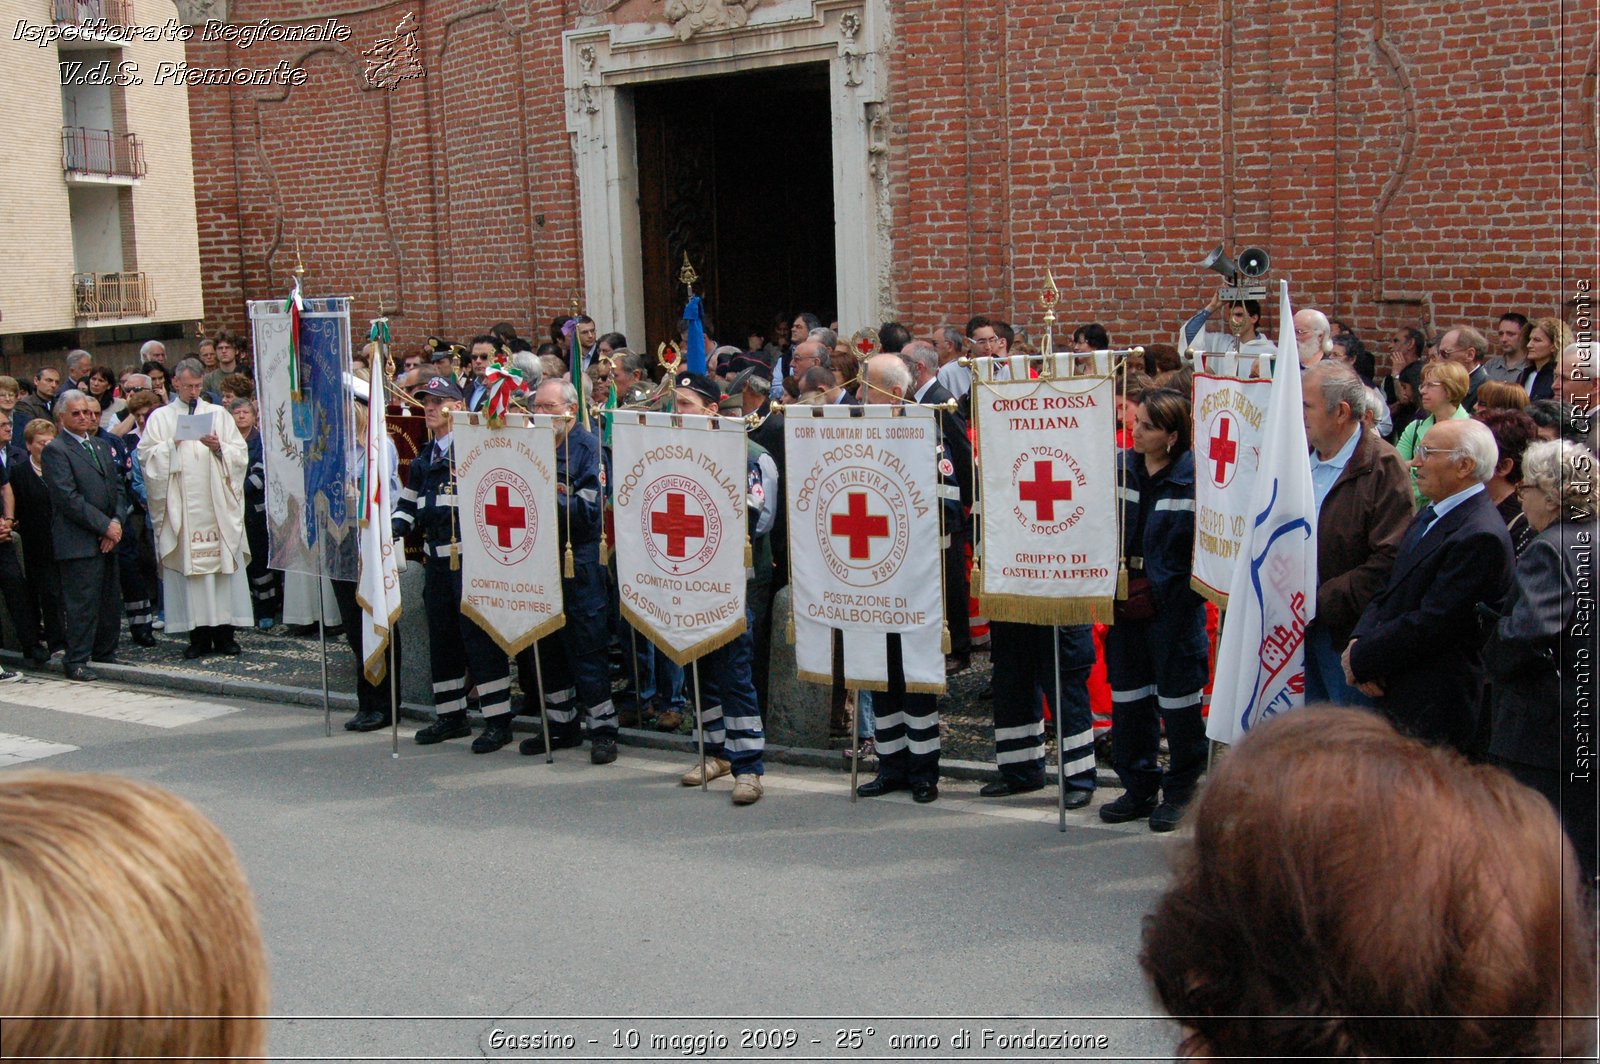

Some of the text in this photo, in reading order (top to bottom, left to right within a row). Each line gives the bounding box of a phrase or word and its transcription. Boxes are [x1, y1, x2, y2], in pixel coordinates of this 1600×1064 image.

[992, 394, 1097, 412] CROCE ROSSA
[1009, 416, 1079, 431] ITALIANA
[820, 427, 863, 439] VOLONTARI
[866, 427, 882, 439] DEL
[885, 427, 925, 440] SOCCORSO
[457, 436, 552, 485] CROCE ROSSA ITALIANA
[1031, 445, 1087, 487] VOLONTARI
[645, 445, 694, 465] ROSSA
[697, 452, 744, 519] ITALIANA
[661, 478, 697, 493] GINEVRA
[823, 443, 874, 467] ROSSA
[877, 449, 929, 519] ITALIANA
[696, 490, 707, 501] 22
[518, 481, 528, 493] 22
[526, 494, 537, 535] AGOSTO
[704, 502, 719, 544] AGOSTO
[817, 470, 907, 581] CONVENZIONE DI GINEVRA 22 AGOSTO 1864
[1013, 505, 1085, 535] DEL SOCCORSO
[698, 546, 714, 563] 1864
[1015, 553, 1087, 564] GRUPPO DI
[1002, 566, 1109, 579] CASTELL'ALFERO
[511, 583, 544, 595] LOCALE
[635, 573, 732, 594] COMITATO LOCALE
[466, 595, 505, 609] SETTMO
[621, 583, 740, 628] GASSINO TORINESE
[672, 596, 681, 605] DI
[823, 591, 907, 608] POSTAZIONE DI
[808, 603, 926, 625] CASALBORGONE
